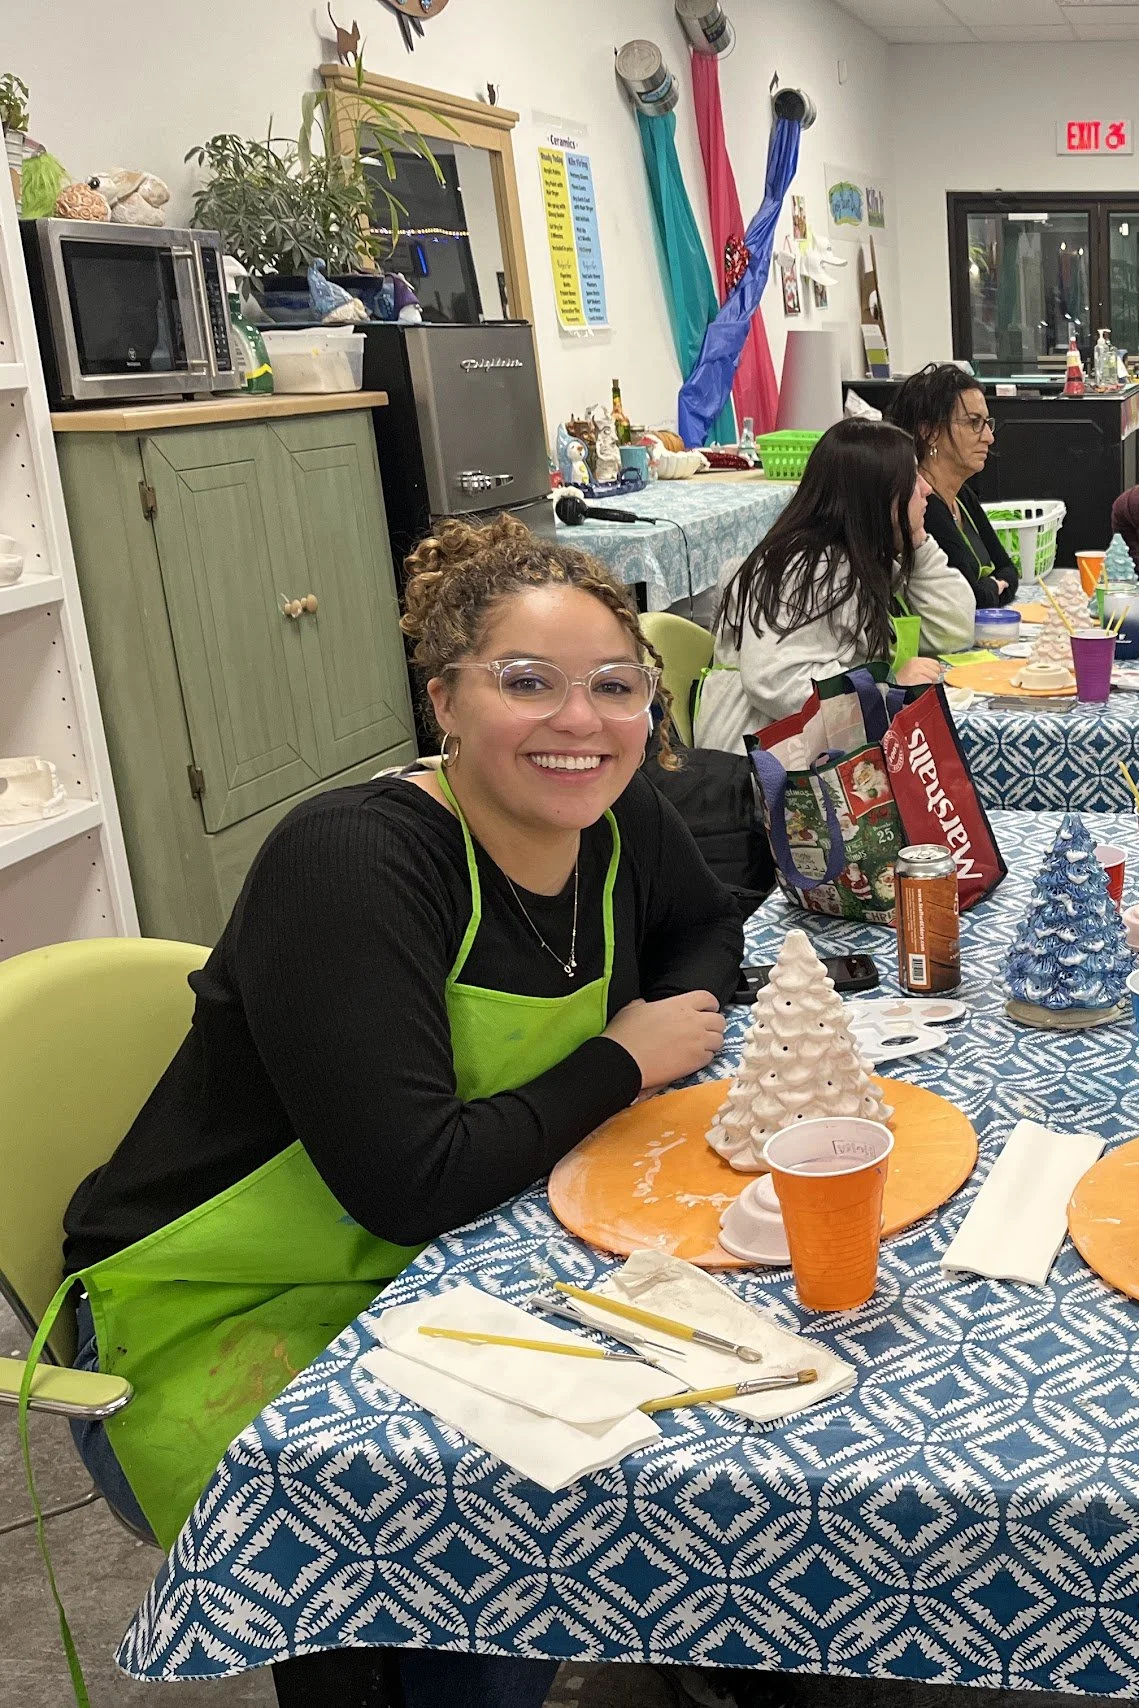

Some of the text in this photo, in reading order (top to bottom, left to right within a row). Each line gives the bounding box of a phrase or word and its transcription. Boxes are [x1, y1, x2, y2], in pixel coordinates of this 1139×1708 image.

[550, 134, 576, 150] Ceramics
[1067, 121, 1101, 150] EXIT
[905, 726, 983, 881] Marshalls
[876, 827, 895, 845] 25
